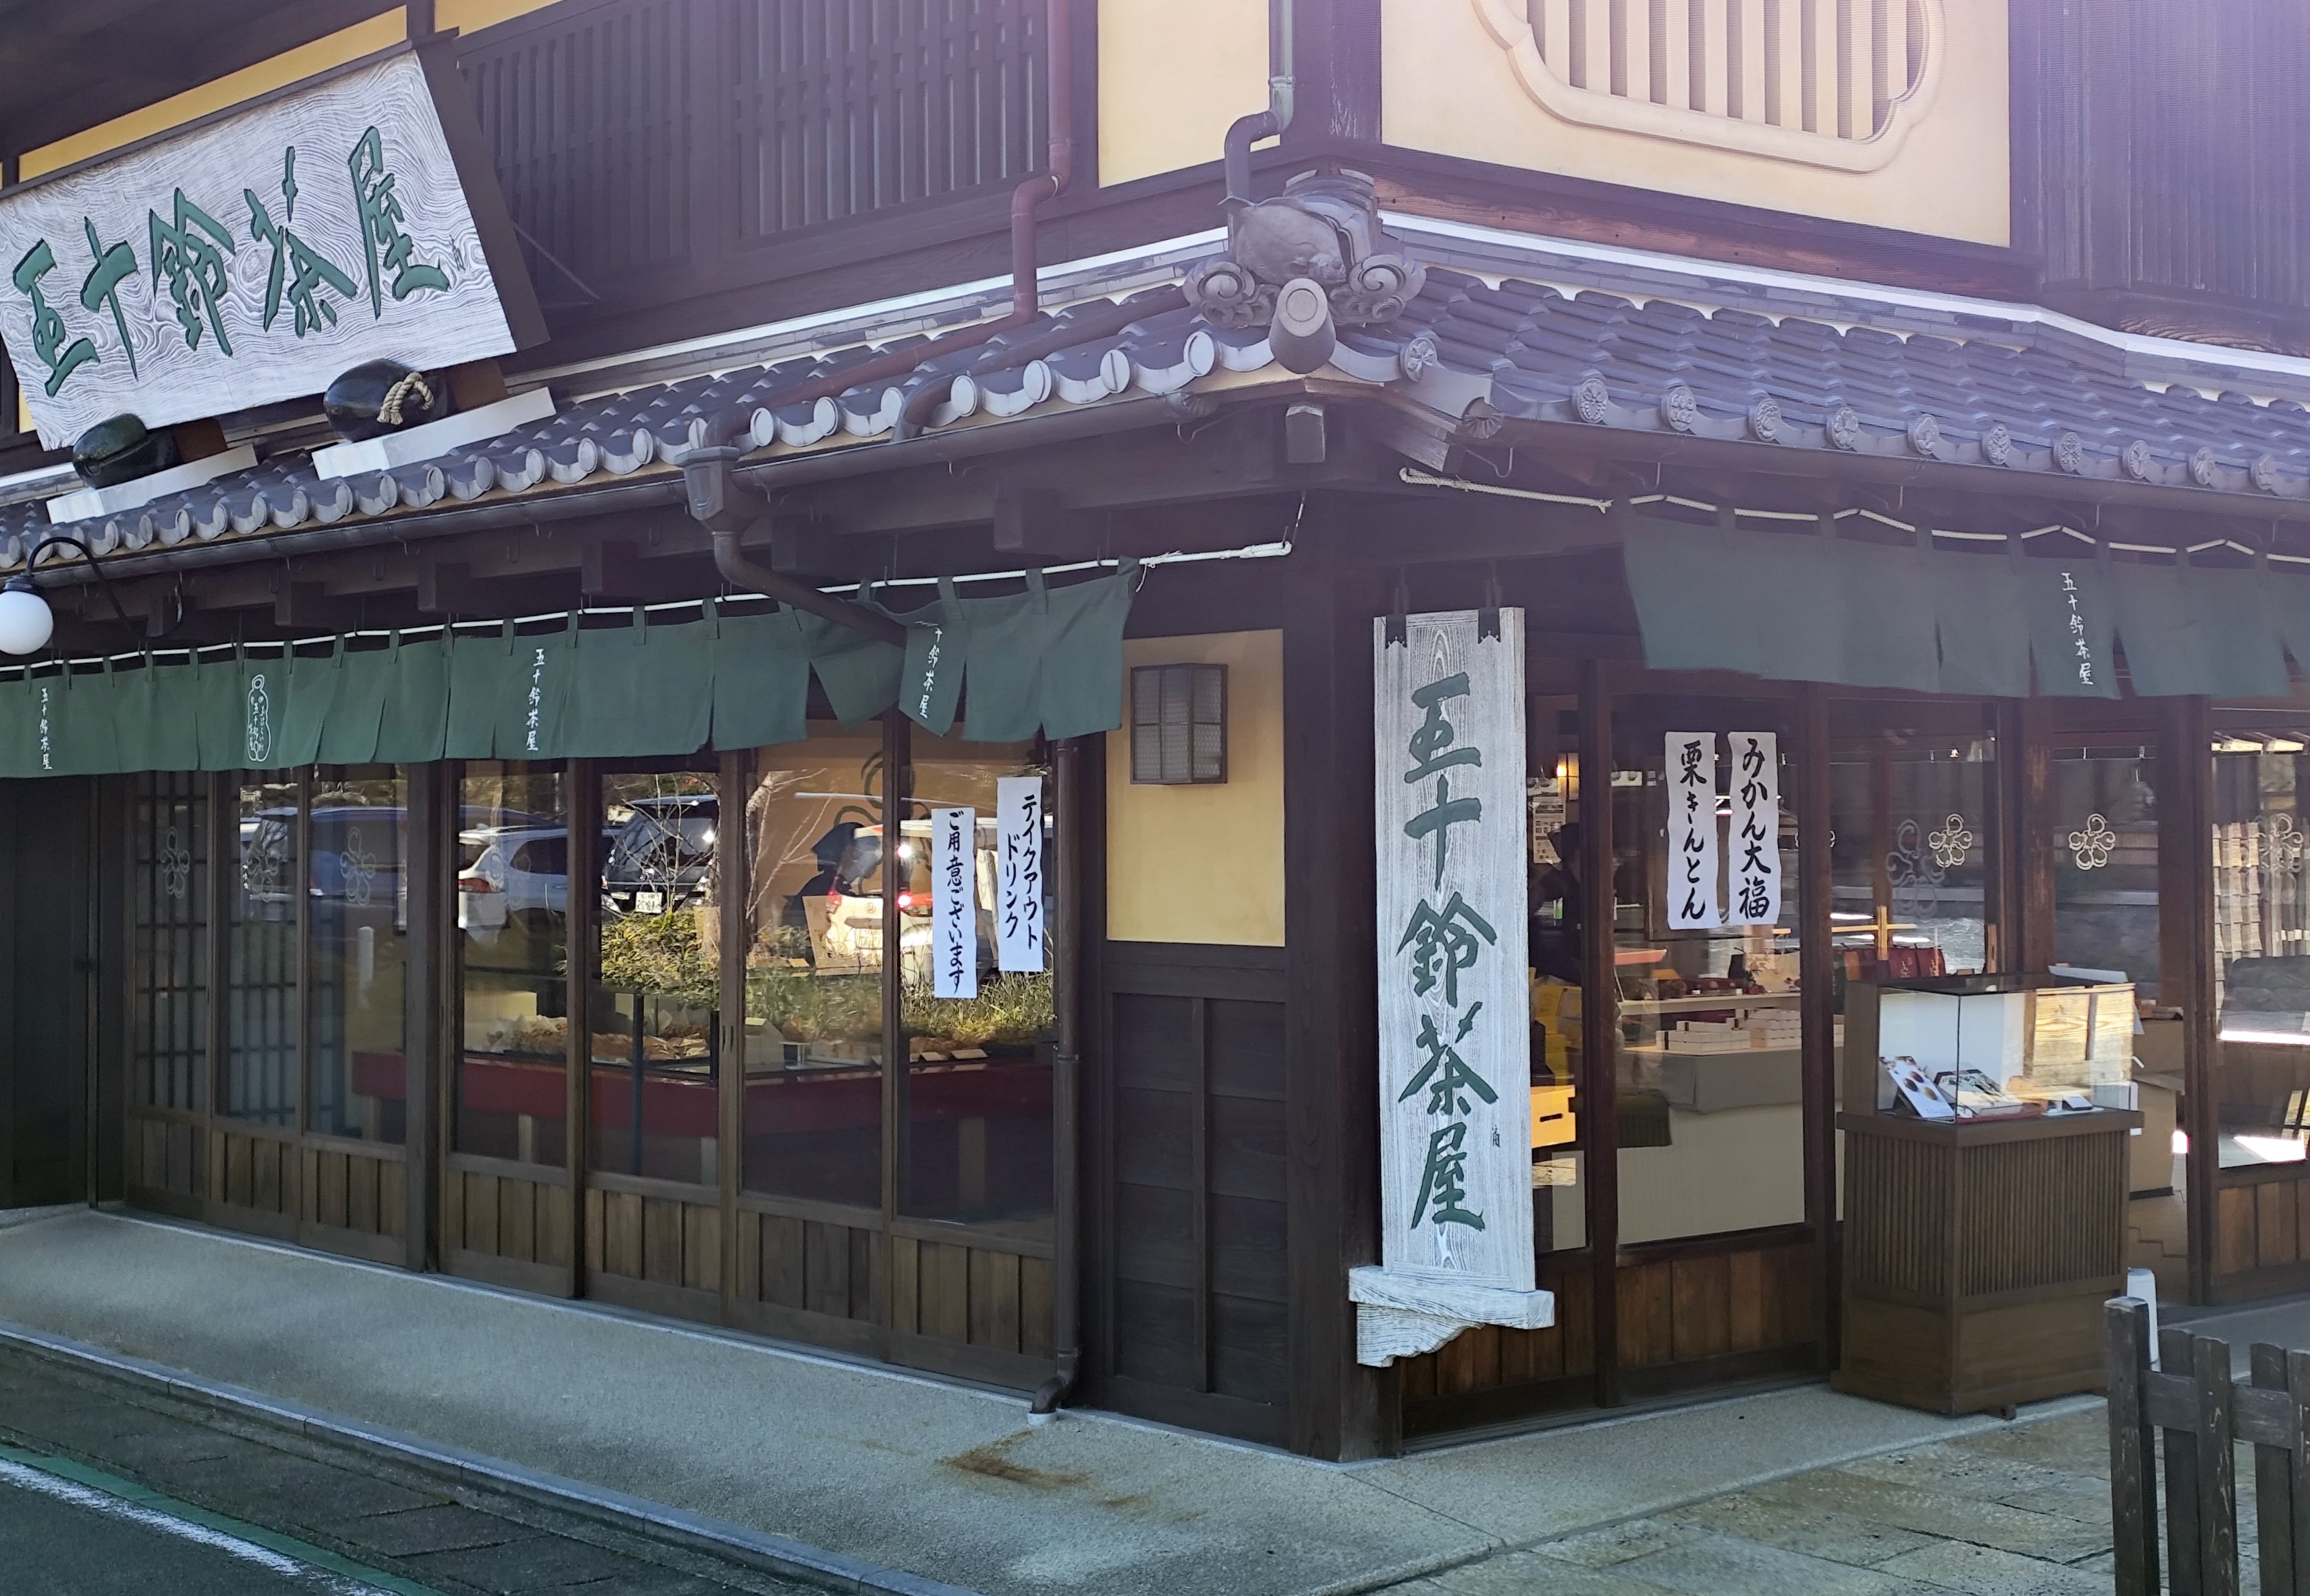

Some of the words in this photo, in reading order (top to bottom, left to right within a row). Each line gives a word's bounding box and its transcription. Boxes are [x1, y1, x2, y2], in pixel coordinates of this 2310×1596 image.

[12, 125, 450, 398] 五十鈴茶屋
[525, 648, 545, 751] 五十鈴茶屋
[2060, 572, 2094, 686] 五十鈴茶屋
[39, 687, 53, 770] 五十鈴茶屋
[945, 811, 964, 995] ご用意ございます
[1005, 833, 1019, 939] ドリンク
[1021, 794, 1038, 950] テイクアウト
[1680, 740, 1707, 920] 栗きんとん
[1738, 738, 1771, 919] みかん大福
[1396, 671, 1499, 1231] 五十鈴茶屋
